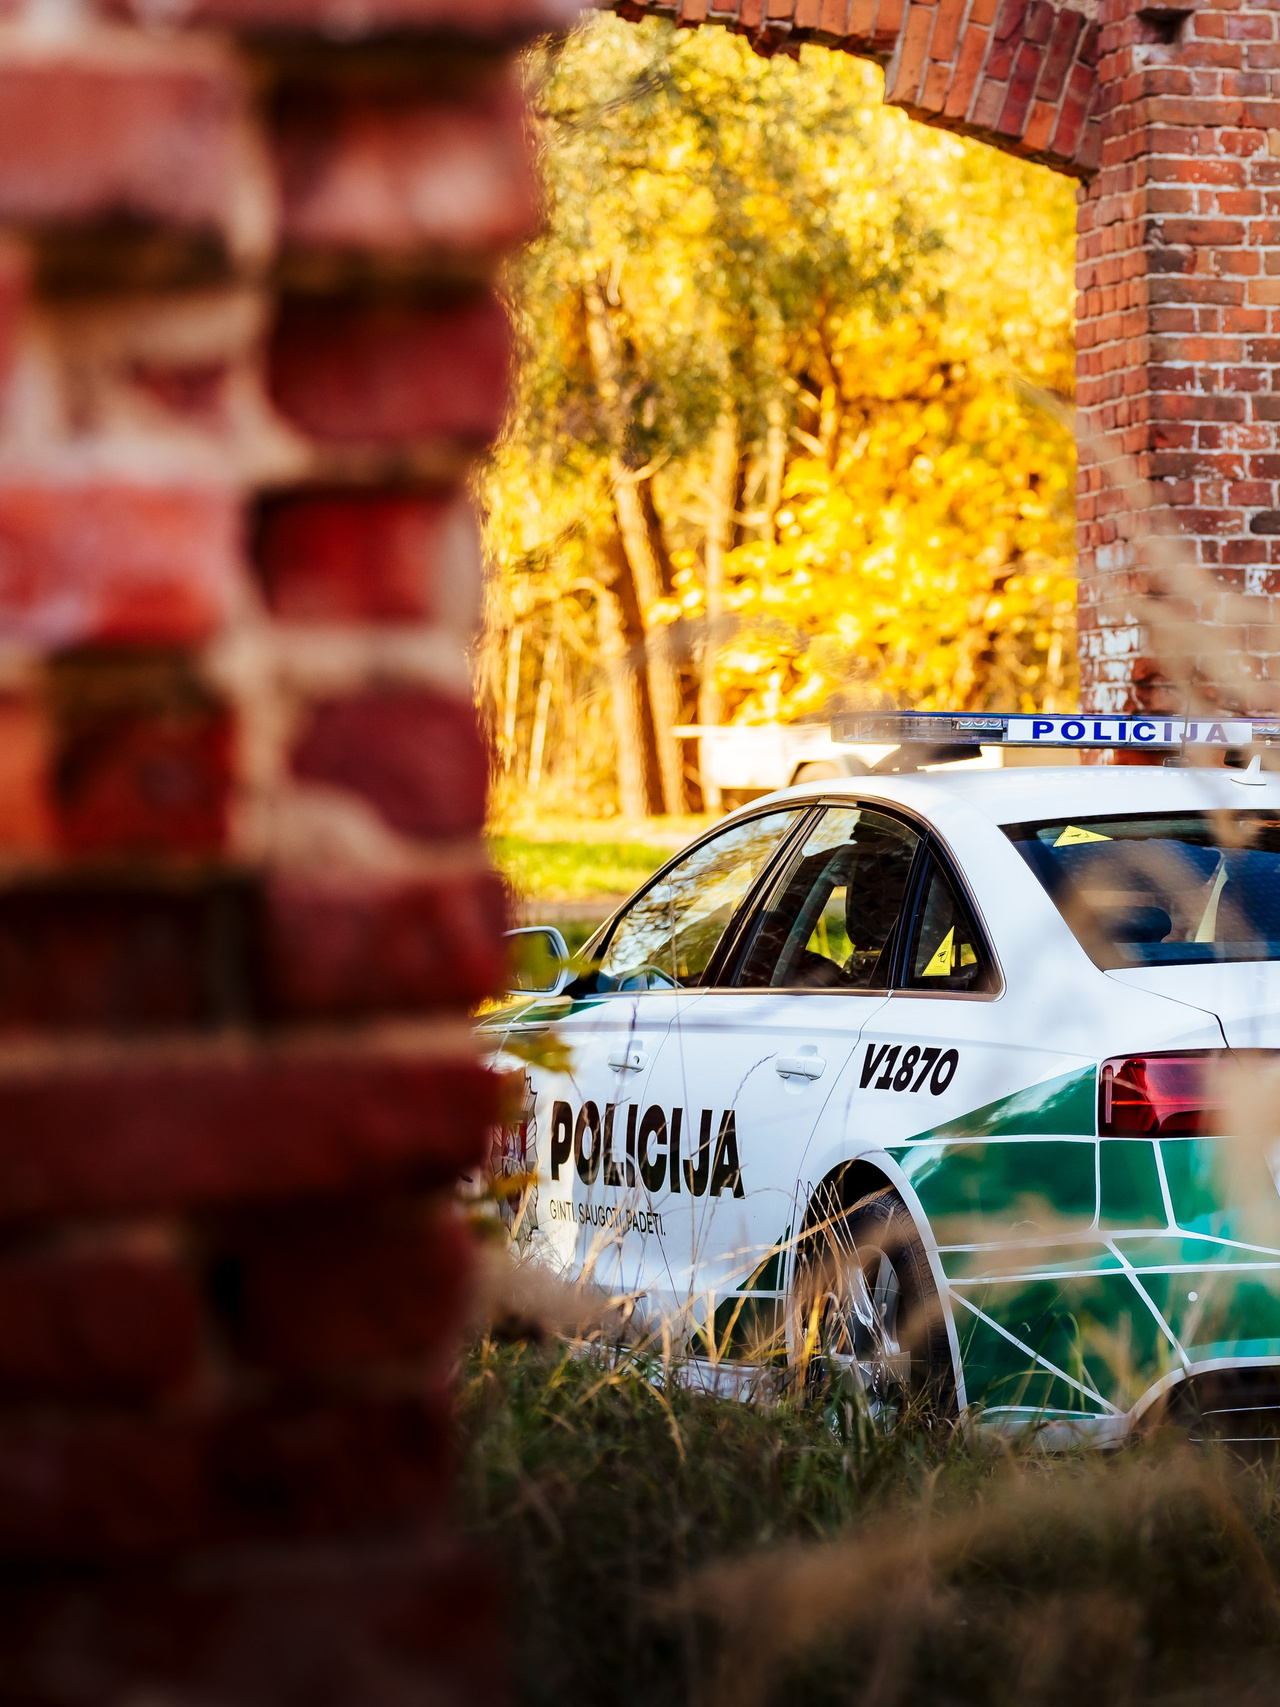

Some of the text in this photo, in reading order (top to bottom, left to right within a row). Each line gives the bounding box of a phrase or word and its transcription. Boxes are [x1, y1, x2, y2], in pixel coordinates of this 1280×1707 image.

[1032, 720, 1229, 743] POLICIJA
[859, 1043, 959, 1096] V1870
[551, 1100, 746, 1199] POLICIJA
